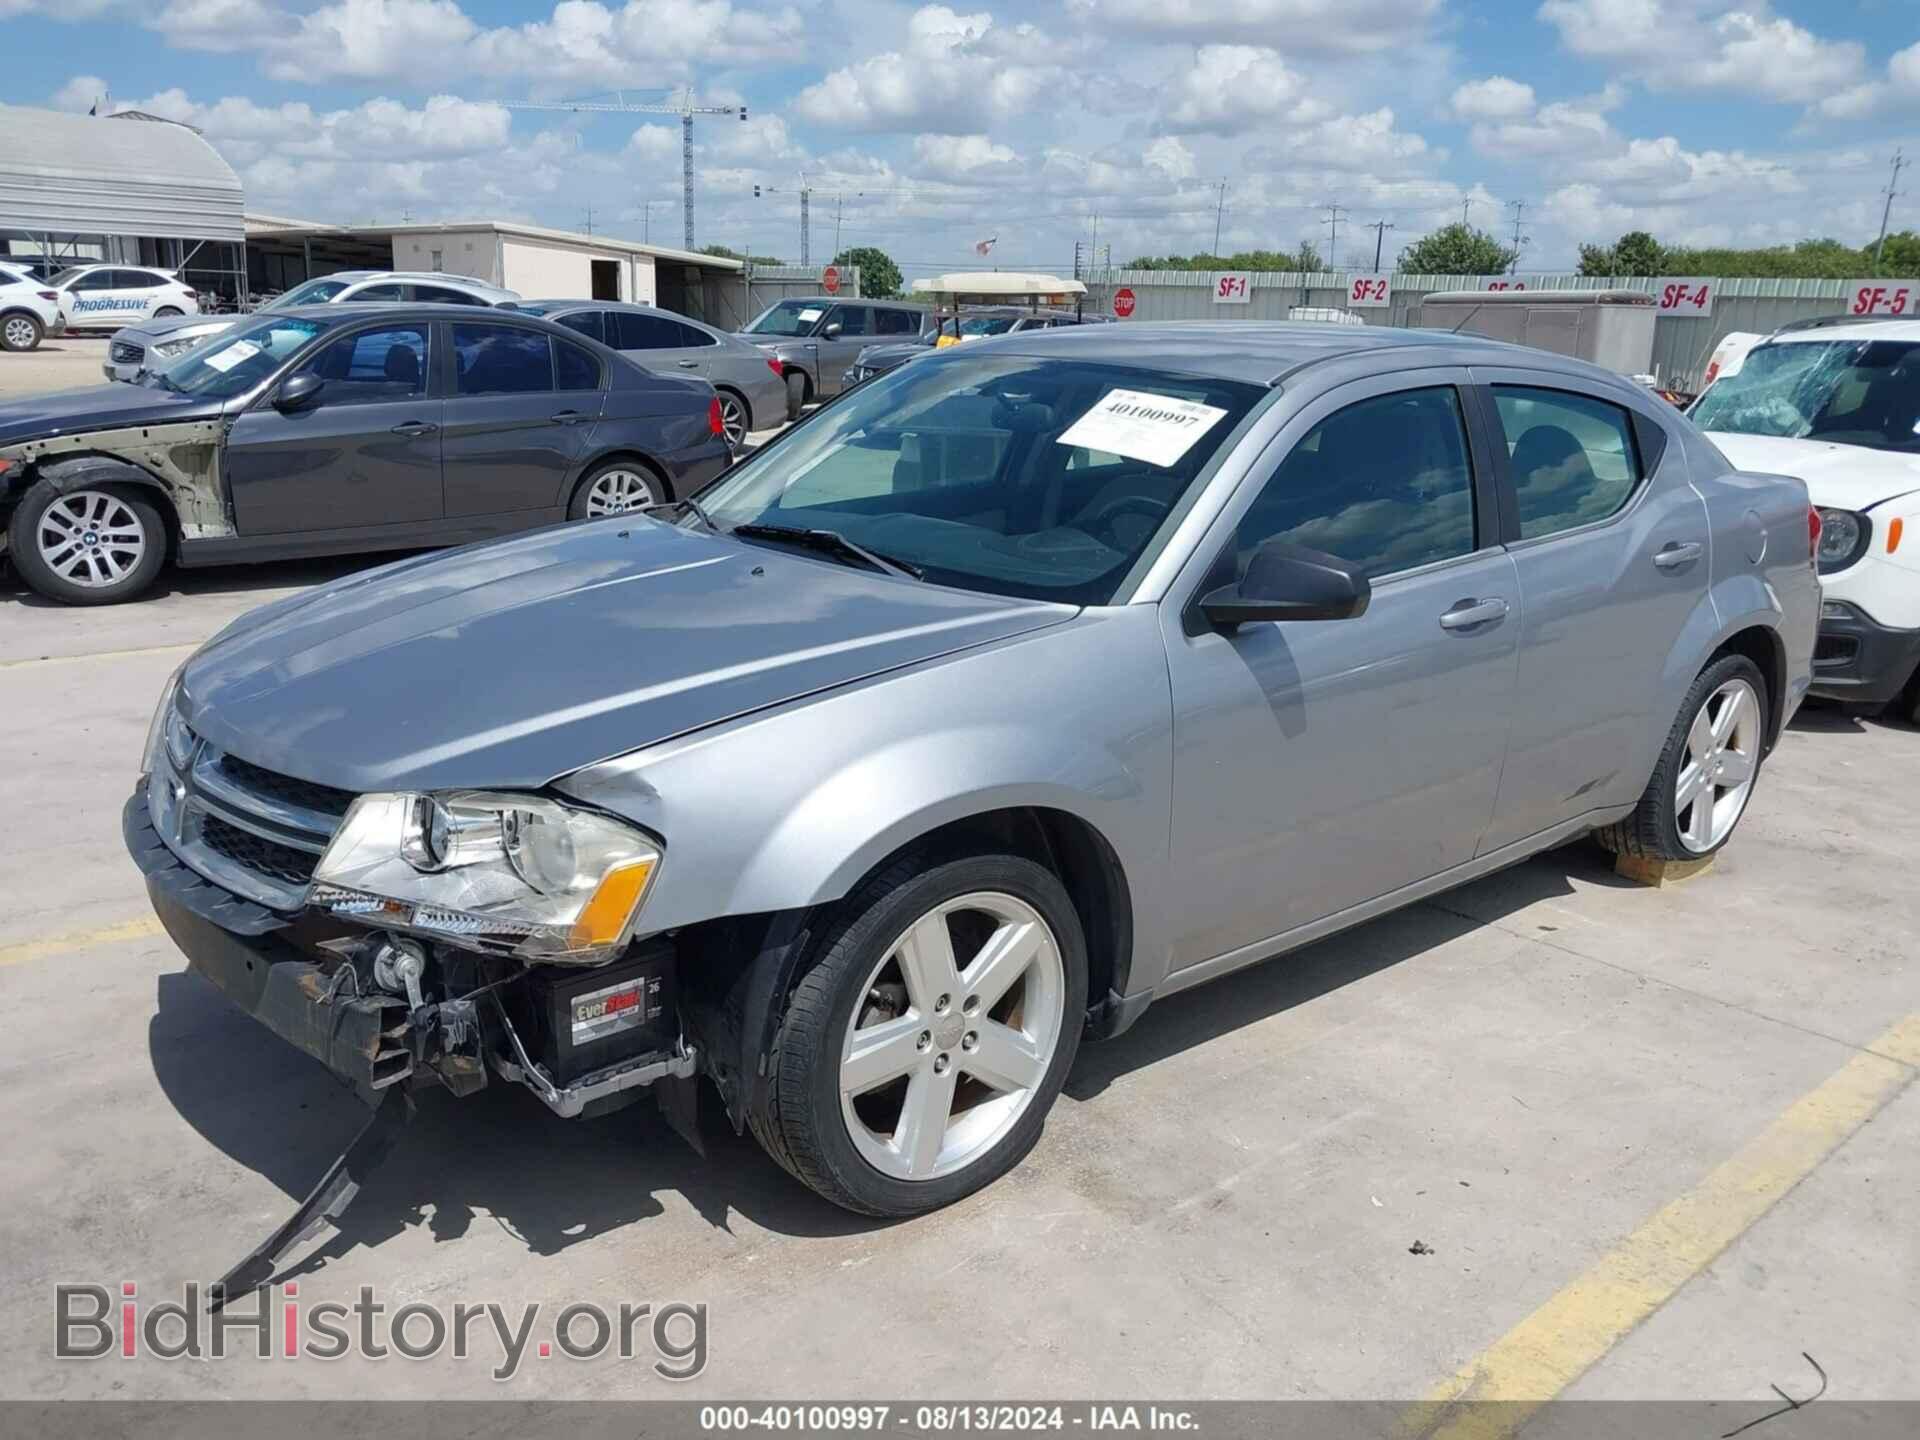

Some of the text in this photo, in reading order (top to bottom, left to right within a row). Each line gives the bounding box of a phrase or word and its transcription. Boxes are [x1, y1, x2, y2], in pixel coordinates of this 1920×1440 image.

[1218, 277, 1246, 297] SF-1
[1352, 279, 1387, 300] SF-2
[1661, 284, 1709, 308] SF-4
[72, 299, 149, 312] PROGRESSIVE
[1114, 296, 1134, 309] STOP
[1854, 287, 1909, 314] SF-5
[1105, 402, 1199, 428] 40100997
